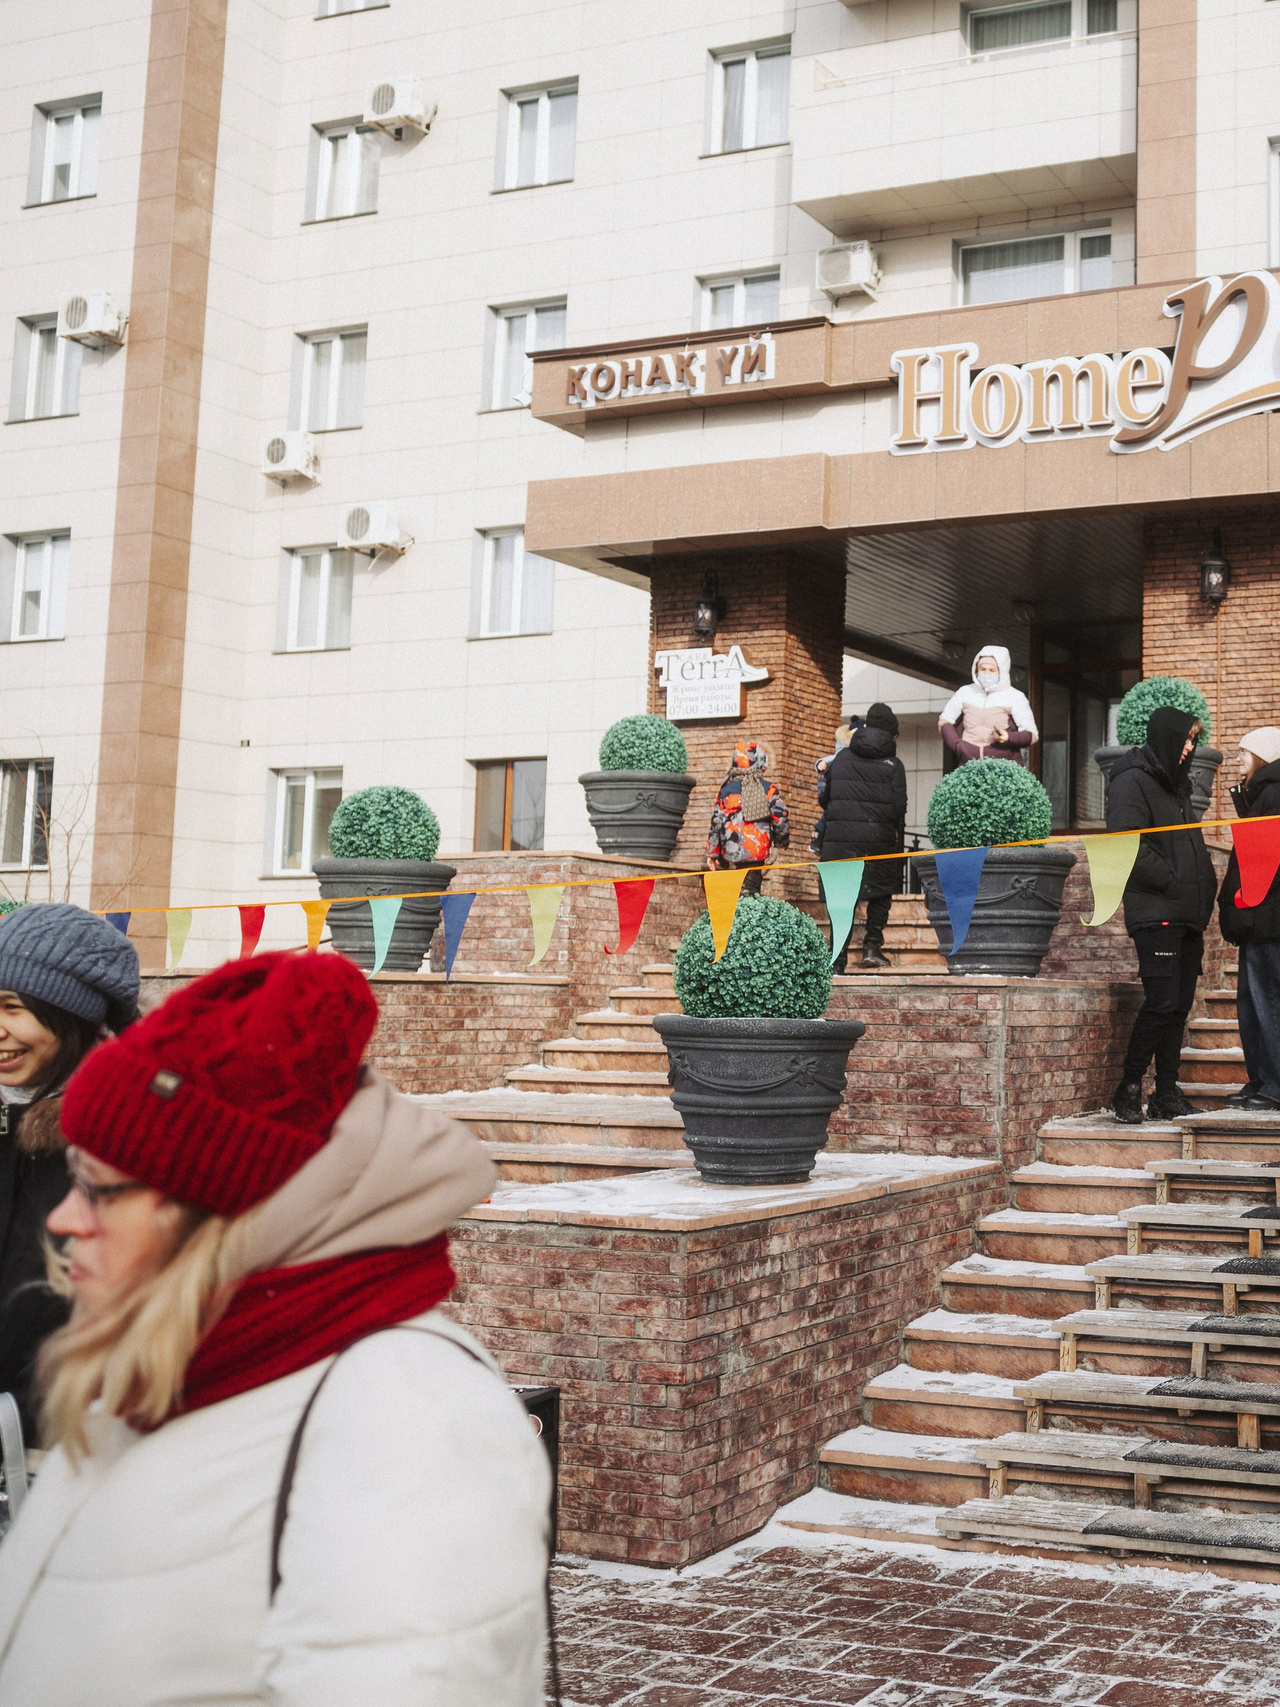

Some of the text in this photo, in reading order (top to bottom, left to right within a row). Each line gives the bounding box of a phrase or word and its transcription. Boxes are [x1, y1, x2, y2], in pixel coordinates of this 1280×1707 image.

[893, 346, 1166, 447] Home
[658, 651, 746, 681] TerrA
[669, 704, 698, 715] 07:00
[707, 702, 737, 713] 24:00
[674, 695, 699, 705] Время
[1183, 1141, 1191, 1156] 7
[1129, 1233, 1137, 1250] 9
[1028, 1410, 1039, 1428] 12
[990, 1478, 1000, 1497] 13
